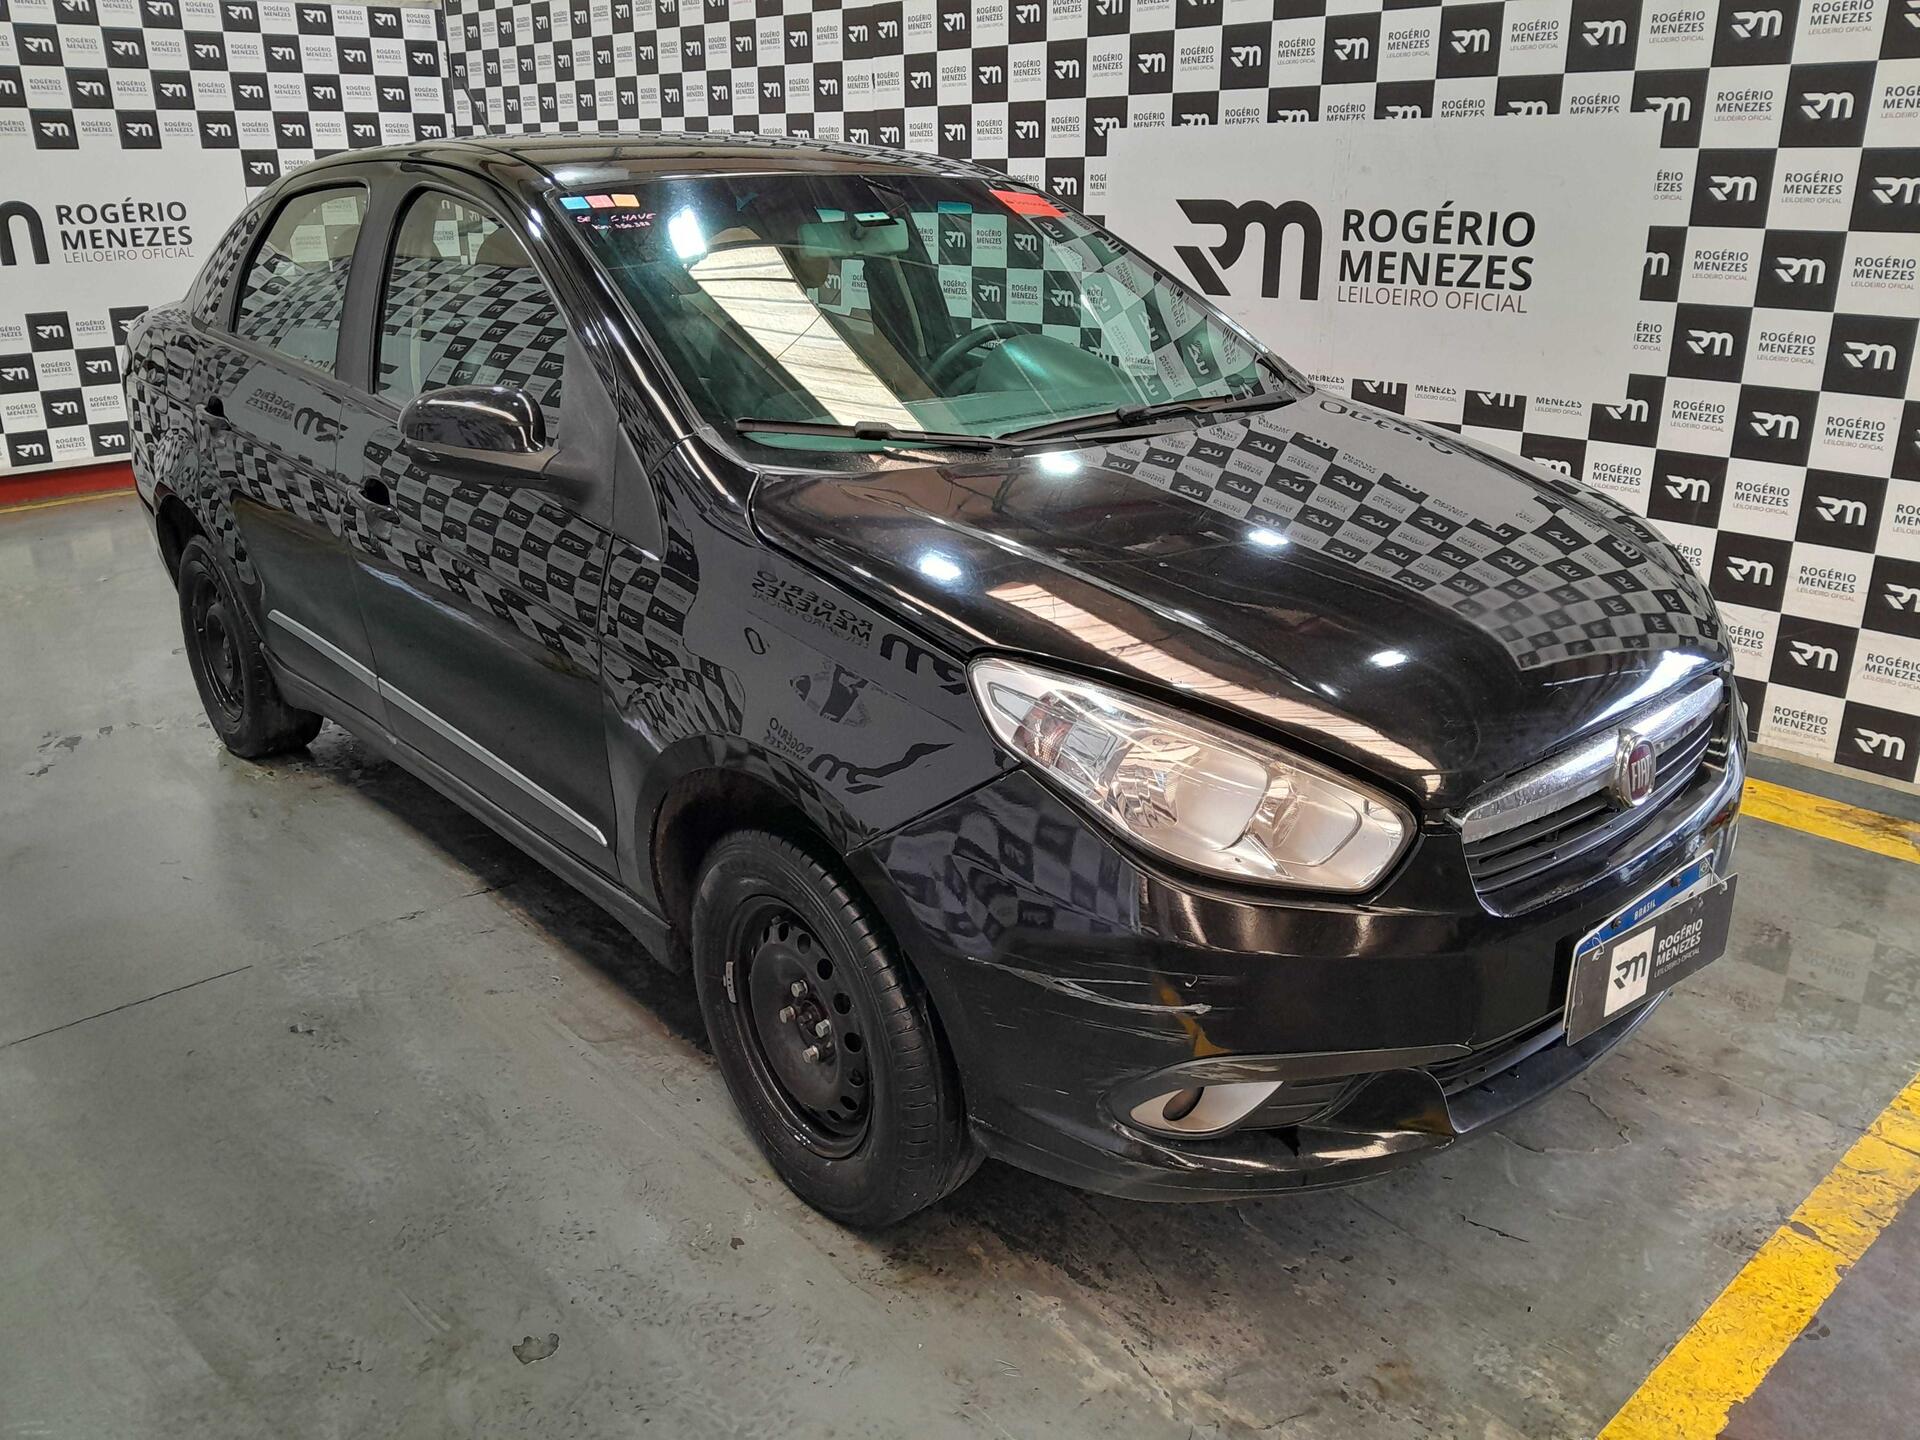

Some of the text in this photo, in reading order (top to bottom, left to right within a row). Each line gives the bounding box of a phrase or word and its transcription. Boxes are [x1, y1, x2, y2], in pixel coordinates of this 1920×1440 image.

[977, 5, 1002, 14] ROGÉRIO
[977, 13, 1003, 22] MENEZES
[1652, 9, 1705, 23] ROGÉRIO
[1810, 12, 1872, 25] MENEZES
[1512, 19, 1559, 32] ROGÉRIO
[1650, 22, 1704, 34] MENEZES
[1388, 28, 1430, 40] ROGÉRIO
[1511, 31, 1558, 42] MENEZES
[1279, 38, 1315, 48] ROGÉRIO
[1388, 39, 1429, 50] MENEZES
[1181, 45, 1214, 55] ROGÉRIO
[1278, 48, 1315, 58] MENEZES
[1014, 59, 1040, 68] ROGÉRIO
[1181, 55, 1214, 64] MENEZES
[942, 65, 966, 74] ROGÉRIO
[1014, 68, 1040, 76] MENEZES
[1571, 93, 1620, 105] ROGÉRIO
[1718, 88, 1773, 101] ROGÉRIO
[1327, 103, 1366, 113] ROGÉRIO
[1442, 98, 1485, 109] ROGÉRIO
[1716, 102, 1772, 112] MENEZES
[1134, 111, 1164, 120] ROGÉRIO
[1225, 107, 1259, 117] ROGÉRIO
[977, 119, 1002, 127] ROGÉRIO
[1052, 115, 1079, 124] ROGÉRIO
[1051, 124, 1079, 132] MENEZES
[1785, 171, 1843, 183] ROGÉRIO
[1784, 184, 1842, 194] MENEZES
[55, 197, 187, 225] ROGÉRIO
[1342, 201, 1536, 248] ROGÉRIO
[61, 226, 193, 250] MENEZES
[64, 247, 194, 264] LEILOEIRO OFICIAL
[1695, 248, 1748, 261] ROGÉRIO
[1694, 261, 1747, 272] MENEZES
[1855, 255, 1916, 268] ROGÉRIO
[1339, 250, 1534, 291] MENEZES
[1853, 269, 1914, 280] MENEZES
[1337, 285, 1528, 314] LEILOEIRO OFICIAL
[1760, 332, 1816, 344] ROGÉRIO
[1759, 343, 1814, 355] MENEZES
[1674, 400, 1725, 413] ROGÉRIO
[1672, 410, 1724, 424] MENEZES
[1828, 416, 1885, 431] ROGÉRIO
[1826, 427, 1884, 442] MENEZES
[1594, 462, 1641, 476] ROGÉRIO
[1593, 472, 1640, 486] MENEZES
[1736, 482, 1790, 496] ROGÉRIO
[1734, 492, 1788, 507] MENEZES
[1801, 566, 1856, 582] ROGÉRIO
[1799, 576, 1854, 593] MENEZES
[1774, 706, 1828, 725] ROGÉRIO
[1773, 716, 1826, 735] MENEZES
[1631, 754, 1651, 792] FIAT
[1633, 899, 1656, 920] BRASIL
[1658, 918, 1703, 951] ROGÉRIO
[1656, 931, 1702, 967] MENEZES
